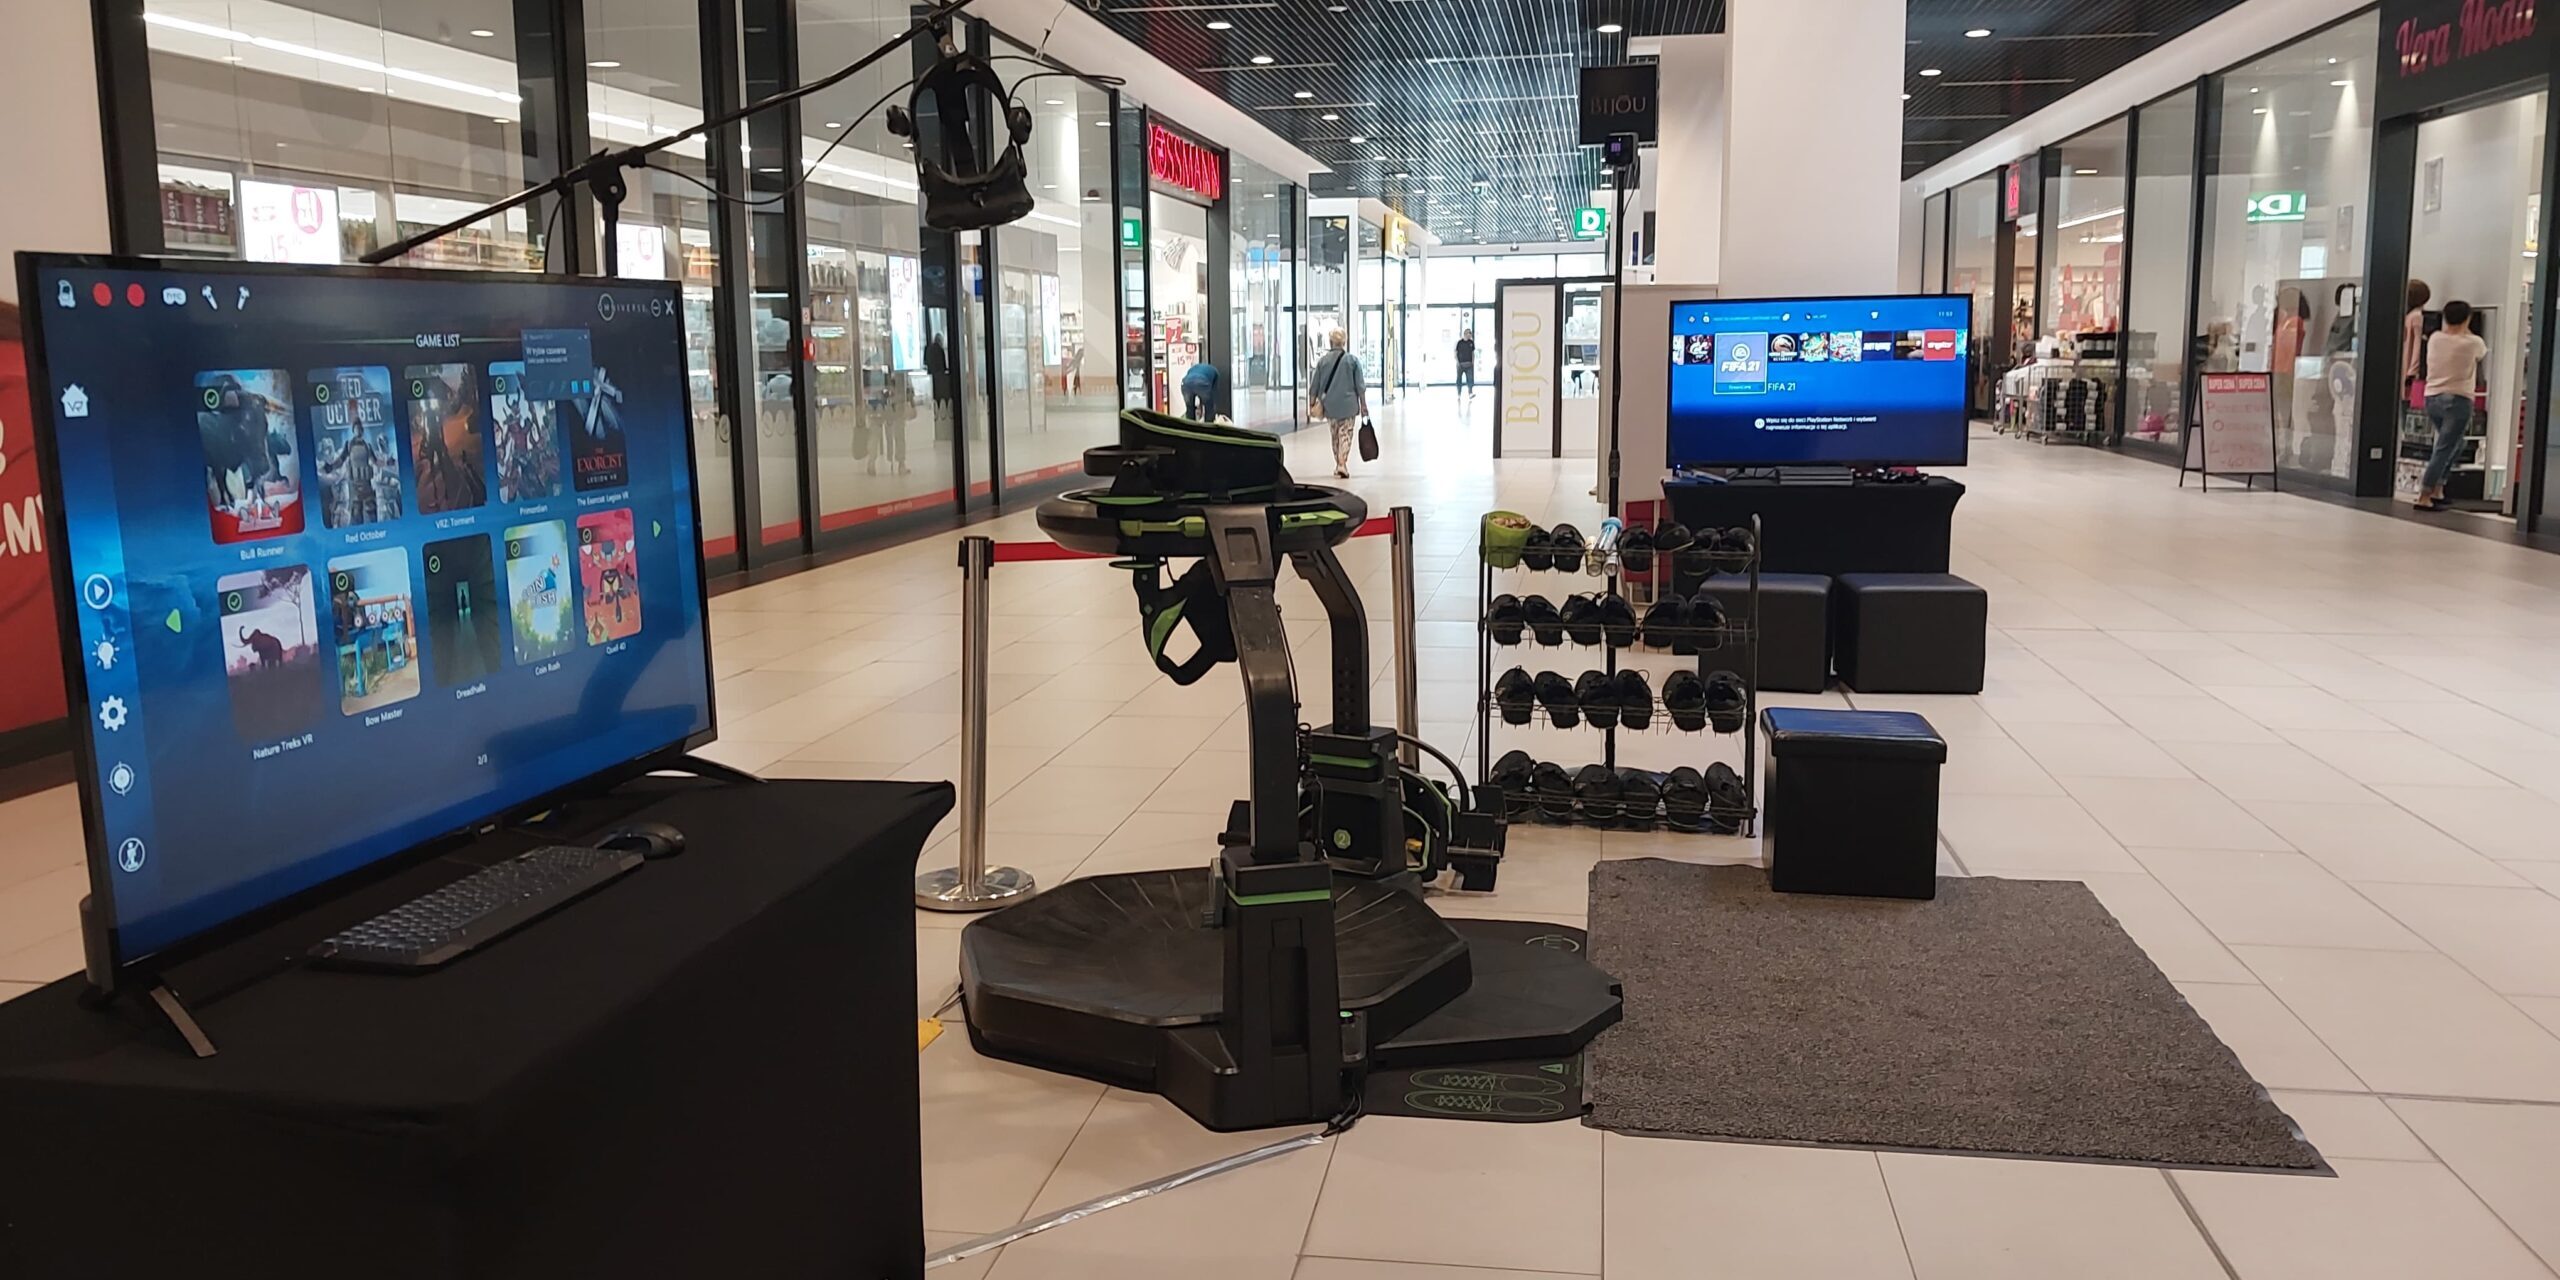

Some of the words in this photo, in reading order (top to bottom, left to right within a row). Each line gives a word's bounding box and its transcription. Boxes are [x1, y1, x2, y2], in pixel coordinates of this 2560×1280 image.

[2396, 17, 2450, 78] Vera
[1581, 209, 1600, 230] D
[416, 334, 442, 348] GAME
[444, 334, 461, 347] LIST
[1721, 361, 1747, 373] FIFA
[1747, 361, 1760, 372] 21
[341, 378, 361, 398] RED
[1768, 383, 1785, 392] FIFA
[1787, 383, 1796, 391] 21
[577, 453, 623, 473] EXORCIST
[450, 516, 476, 528] Torment
[345, 532, 359, 543] Red
[360, 529, 388, 542] October
[240, 548, 256, 561] Bull
[257, 545, 285, 559] Runner
[535, 664, 547, 676] Coin
[365, 714, 380, 727] Bow
[381, 708, 403, 723] Master
[253, 741, 281, 760] Nature
[281, 736, 302, 752] Treks
[302, 733, 314, 747] VR
